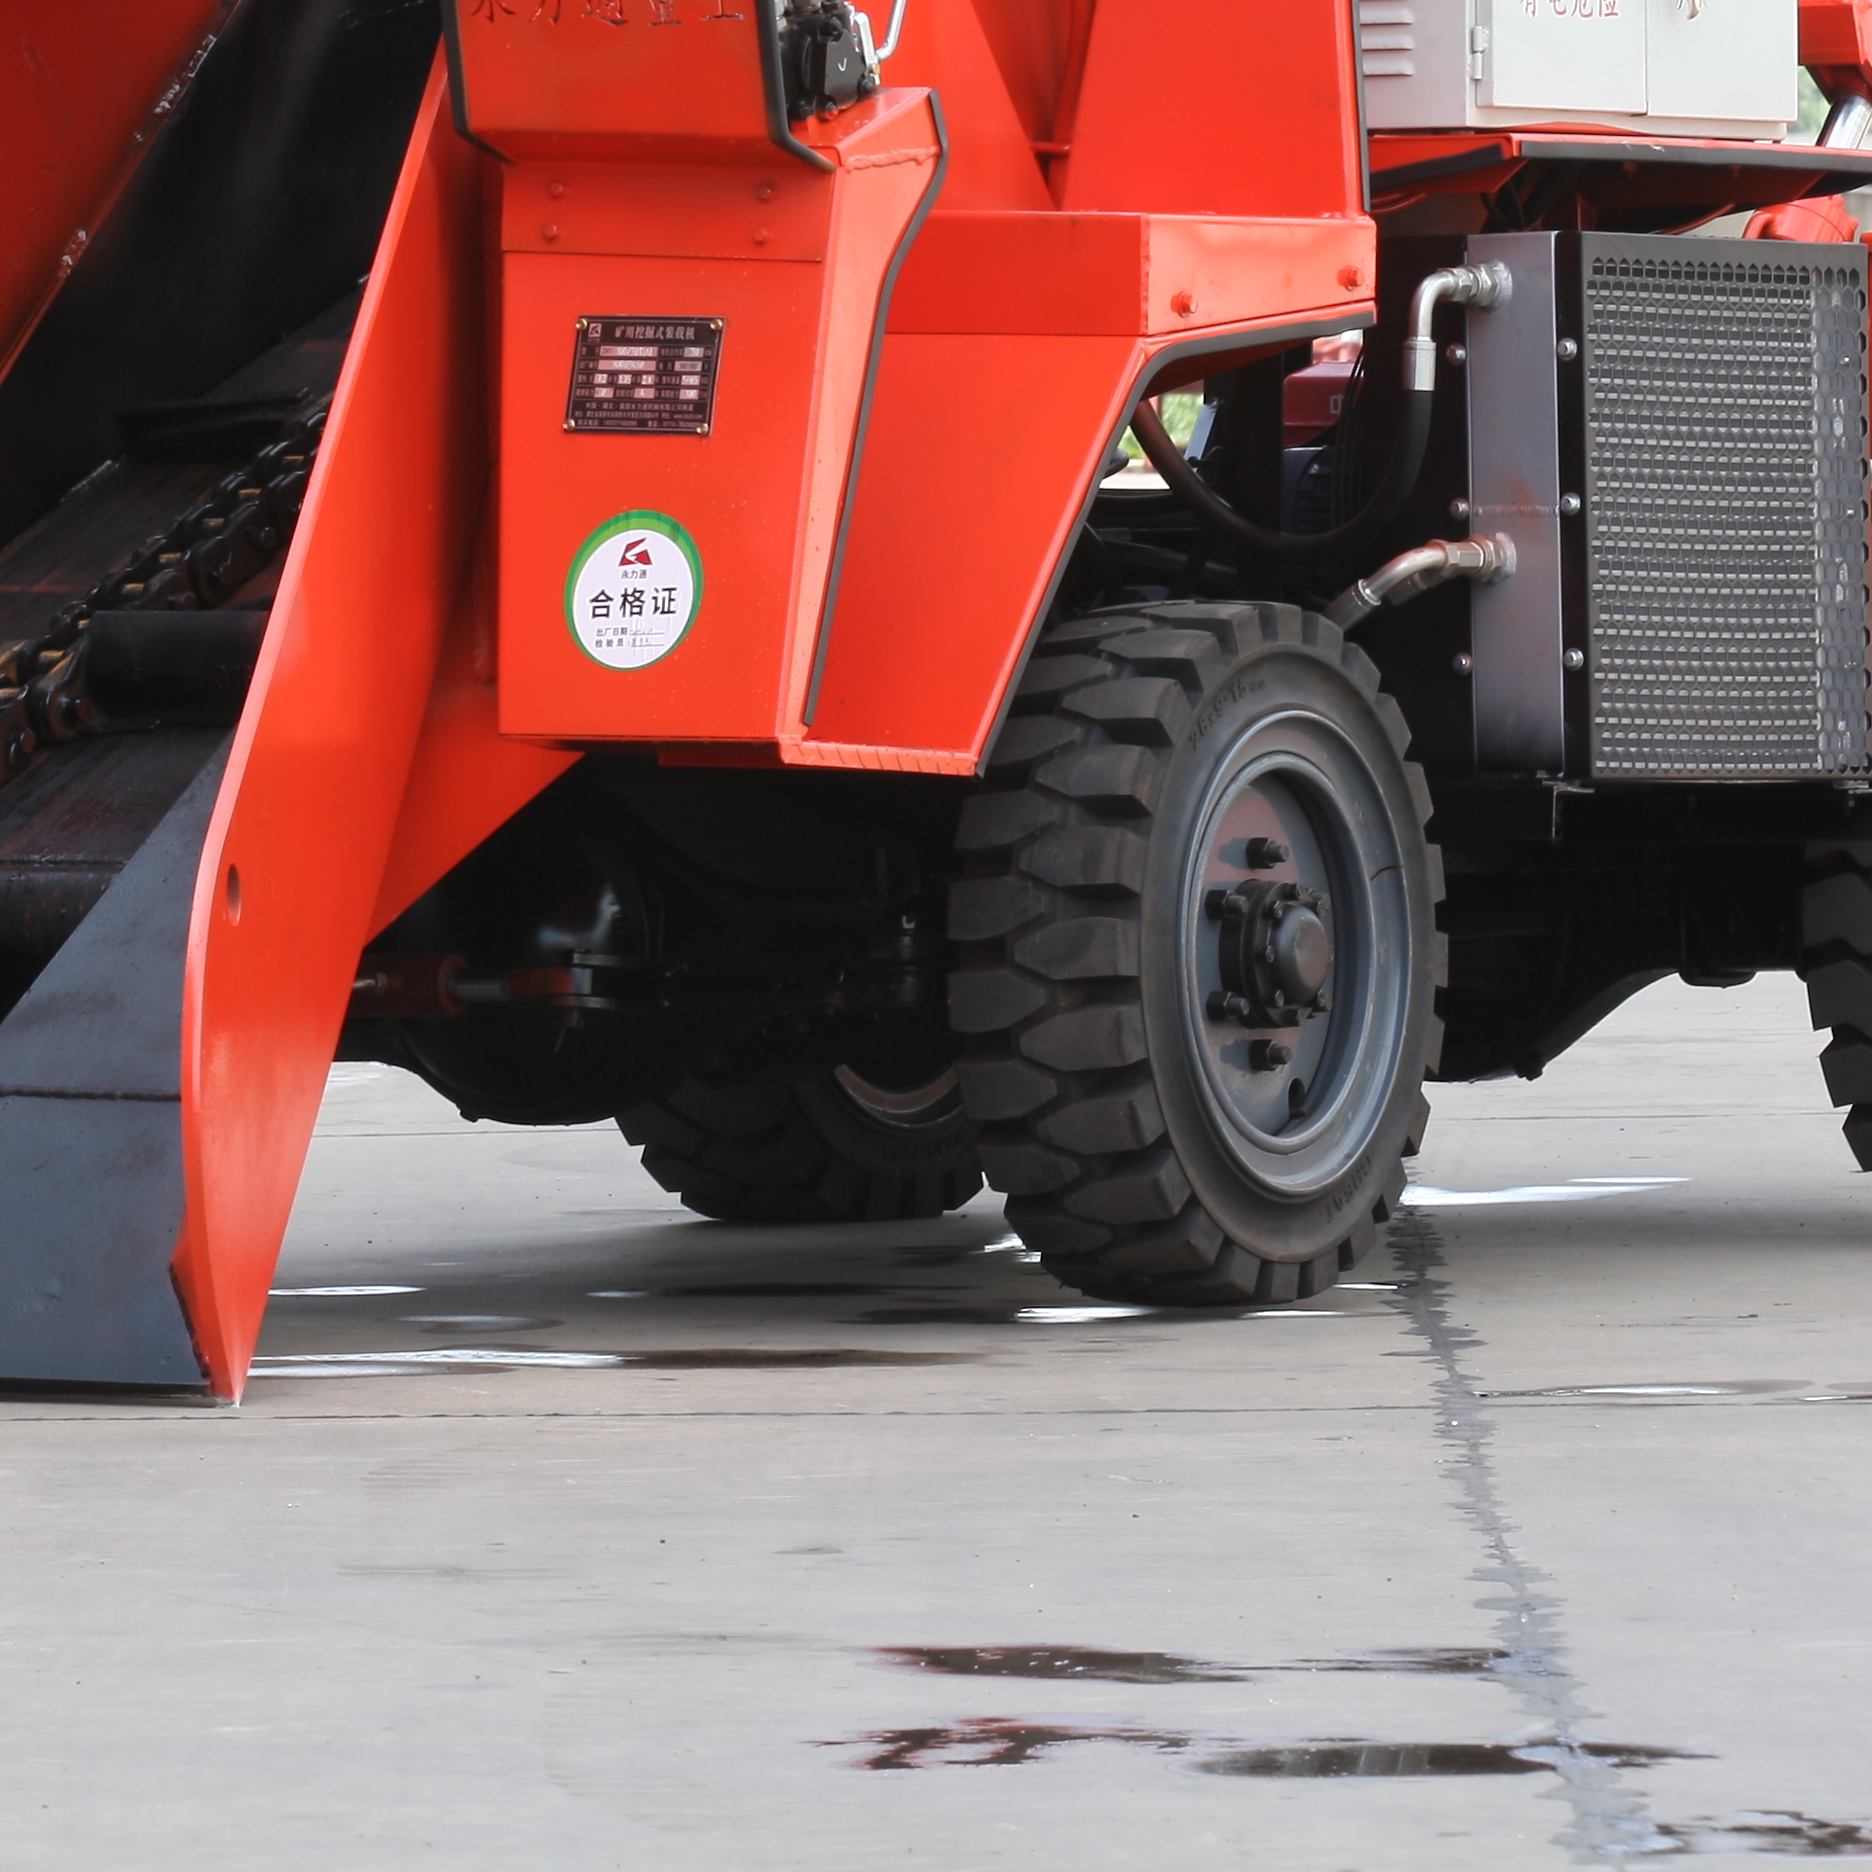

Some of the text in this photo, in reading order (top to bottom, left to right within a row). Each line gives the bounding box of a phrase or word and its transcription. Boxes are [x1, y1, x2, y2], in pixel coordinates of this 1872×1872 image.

[620, 569, 648, 580] 永力通
[588, 586, 678, 619] 合格证
